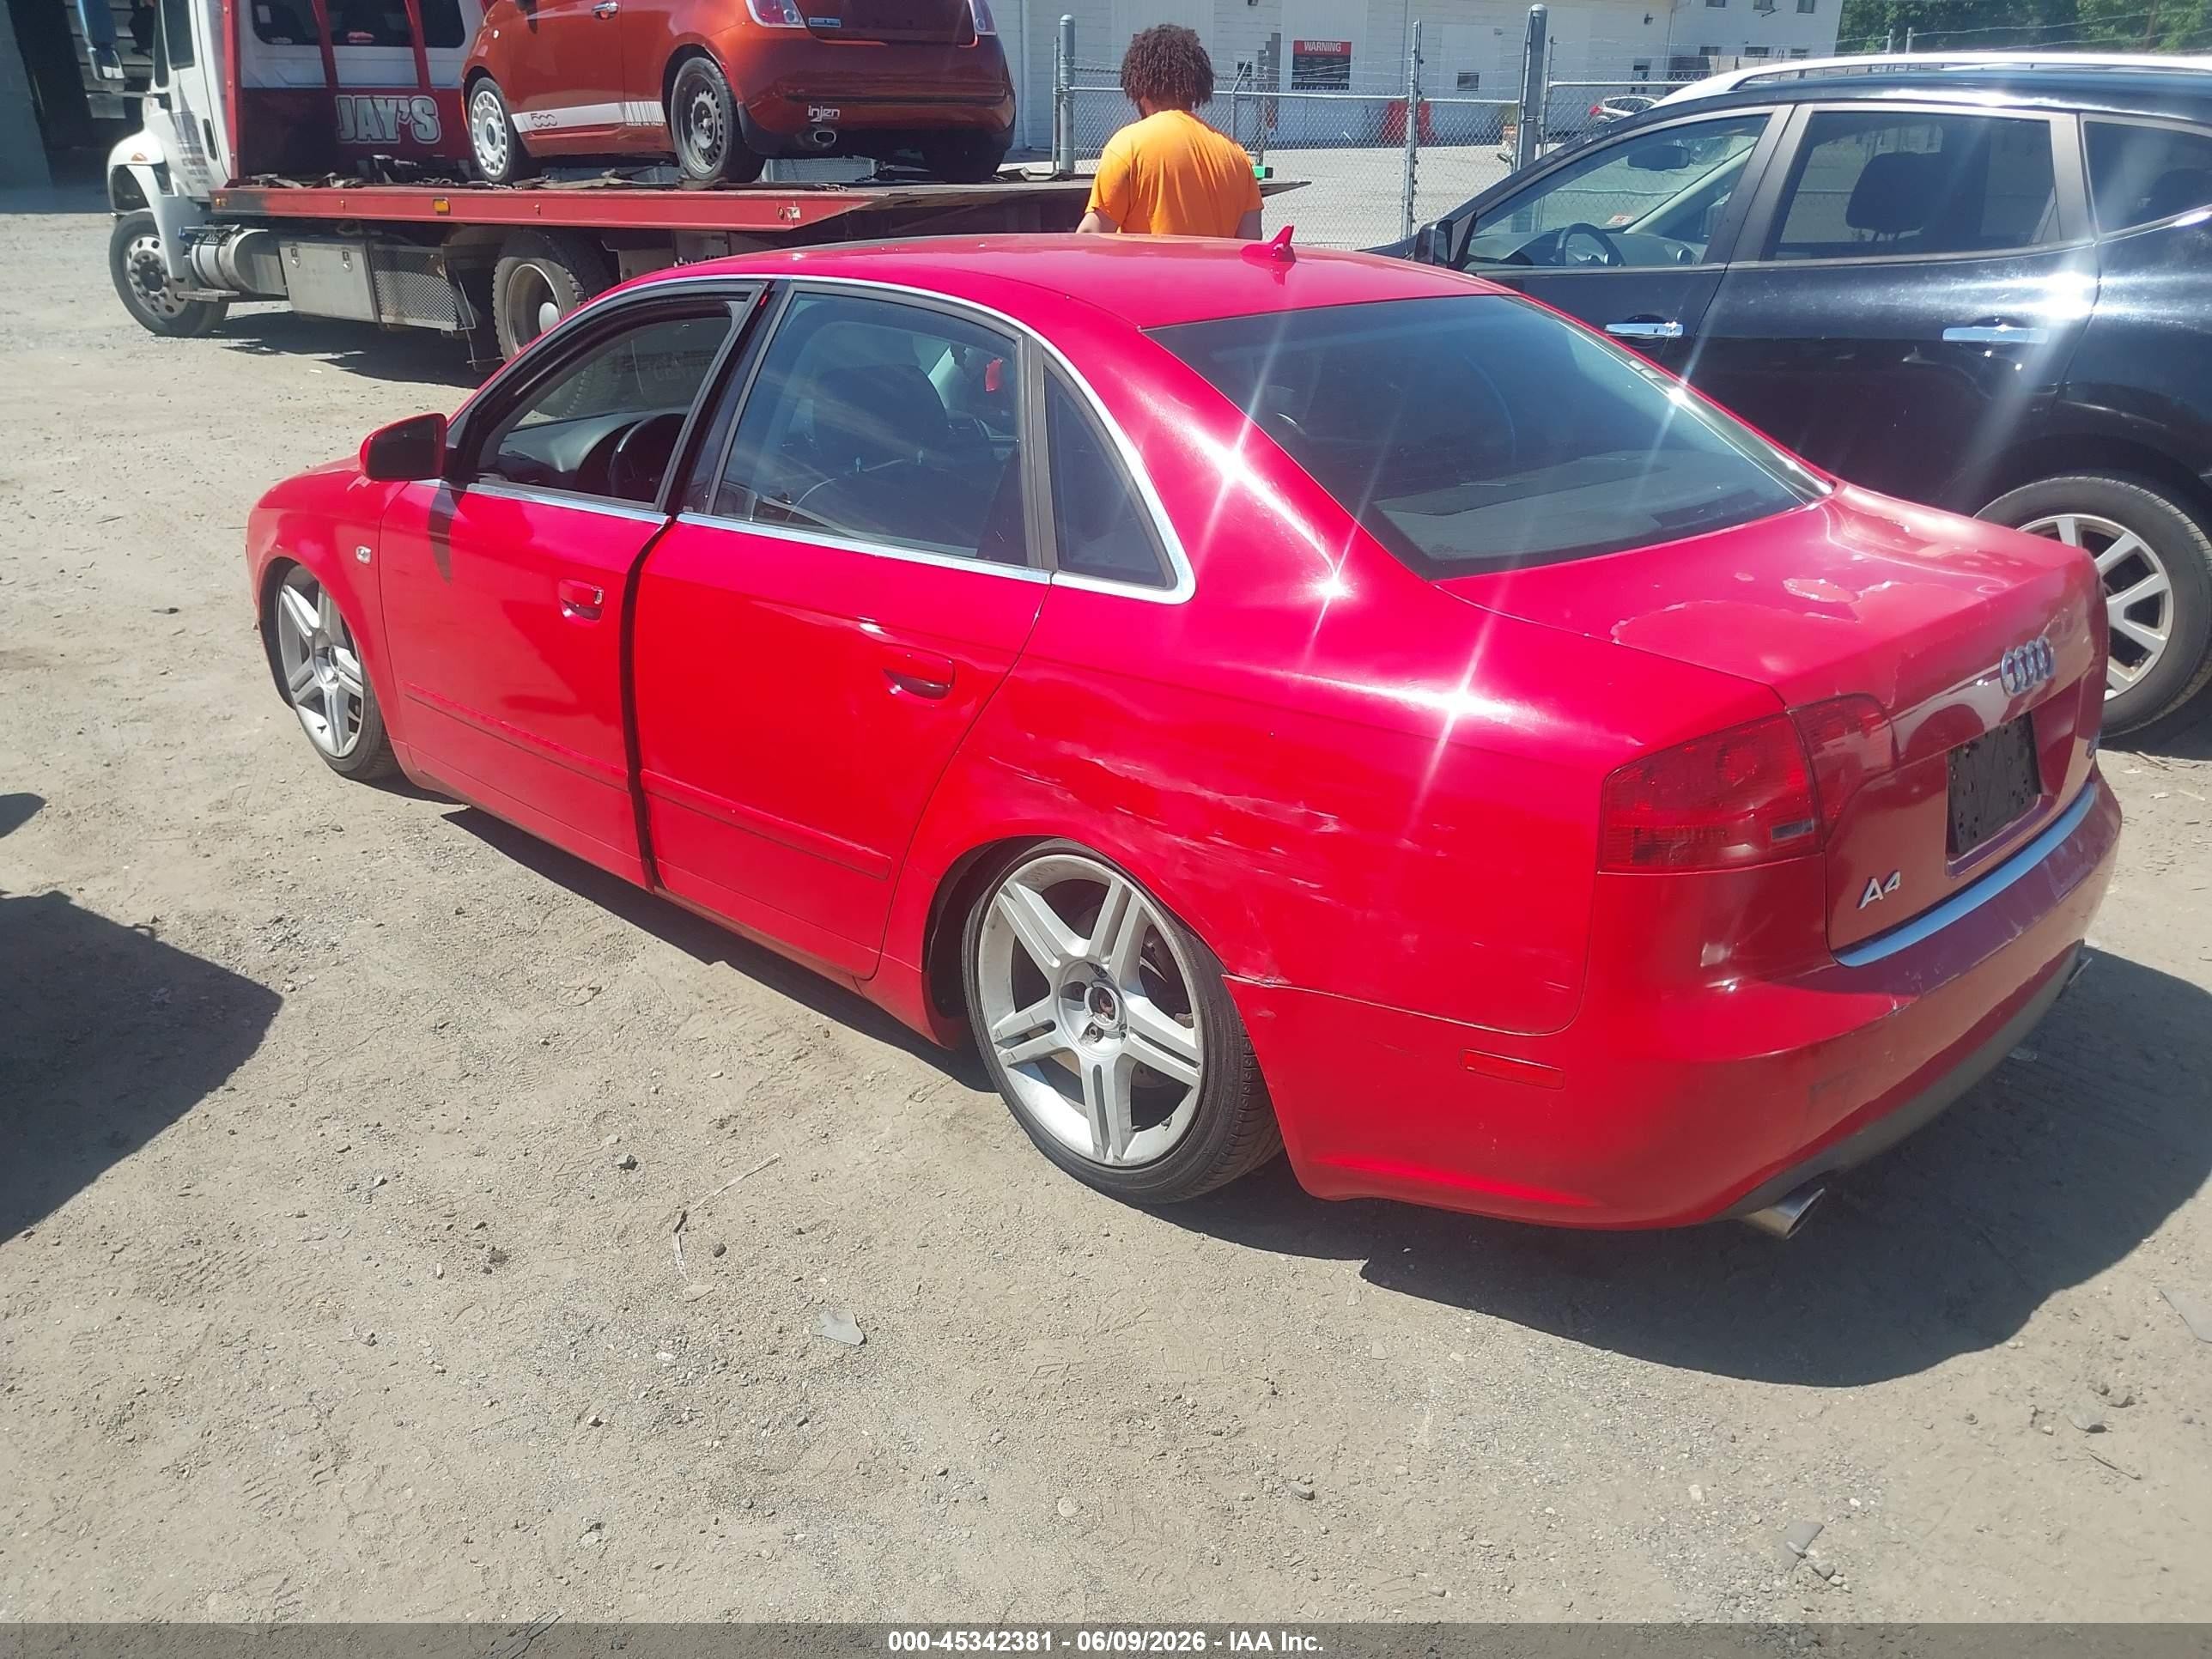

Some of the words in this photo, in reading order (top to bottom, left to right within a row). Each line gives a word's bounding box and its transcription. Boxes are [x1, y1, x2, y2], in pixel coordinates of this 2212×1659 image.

[1304, 41, 1341, 52] WARNING
[336, 94, 441, 144] JAY'S
[530, 112, 557, 128] 500
[808, 105, 841, 122] injen
[1858, 870, 1901, 909] A4
